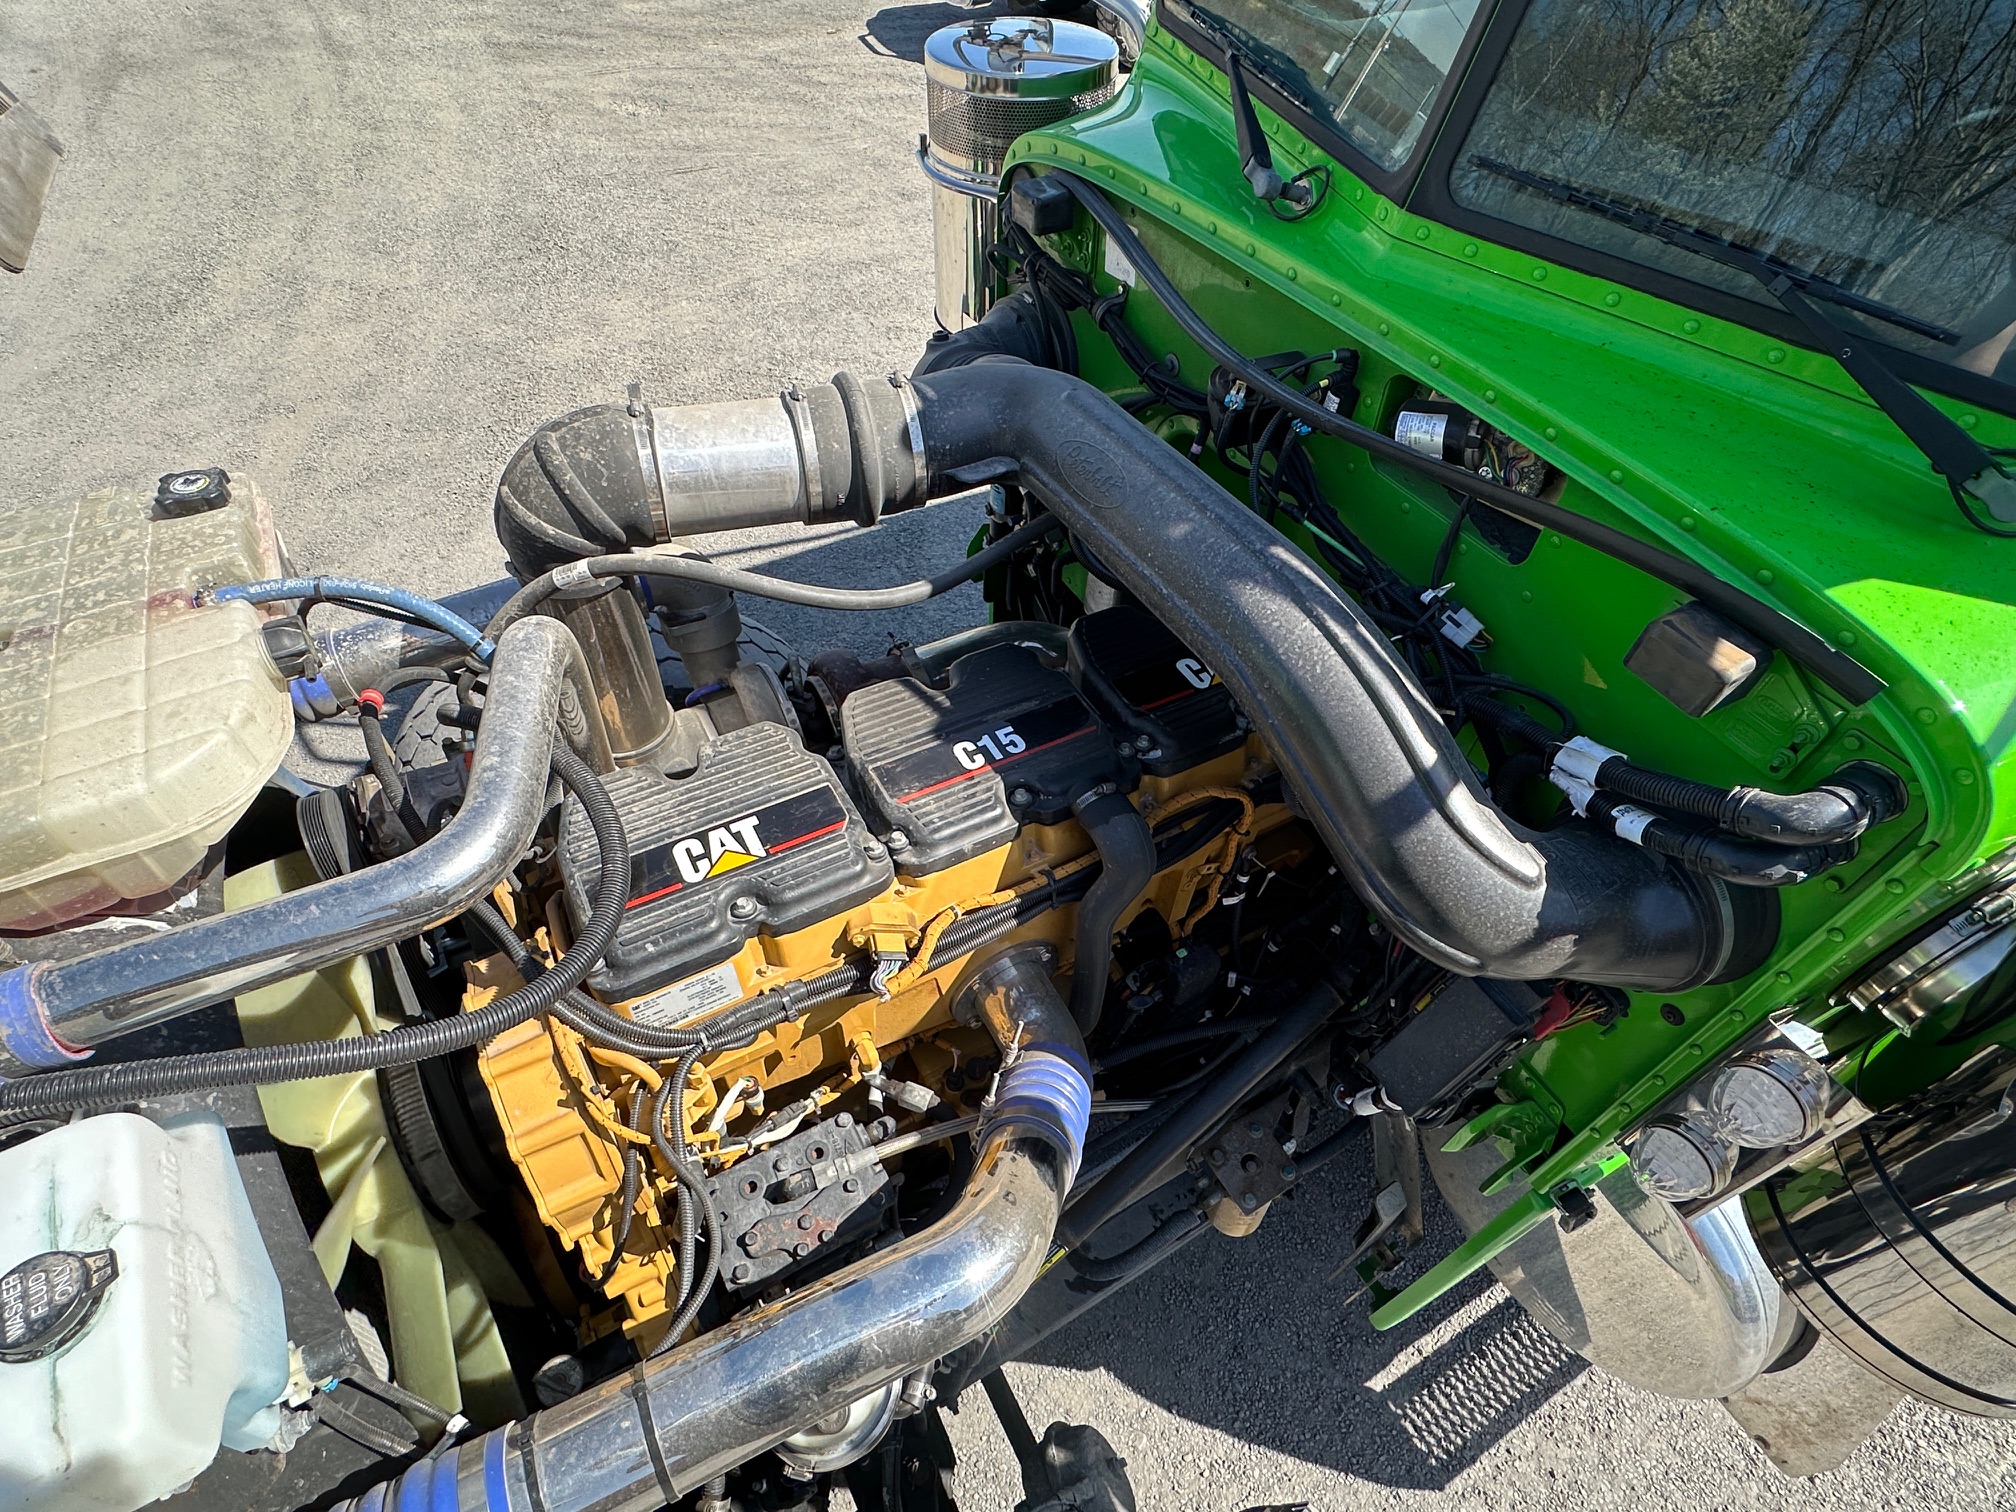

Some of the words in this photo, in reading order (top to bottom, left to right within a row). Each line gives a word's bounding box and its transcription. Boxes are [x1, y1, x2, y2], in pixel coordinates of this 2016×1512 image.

[953, 725, 1027, 771] C15
[672, 815, 767, 884] CAT
[28, 1272, 50, 1320] FLUID
[52, 1263, 73, 1301] ONLY
[2, 1272, 27, 1344] WASHER
